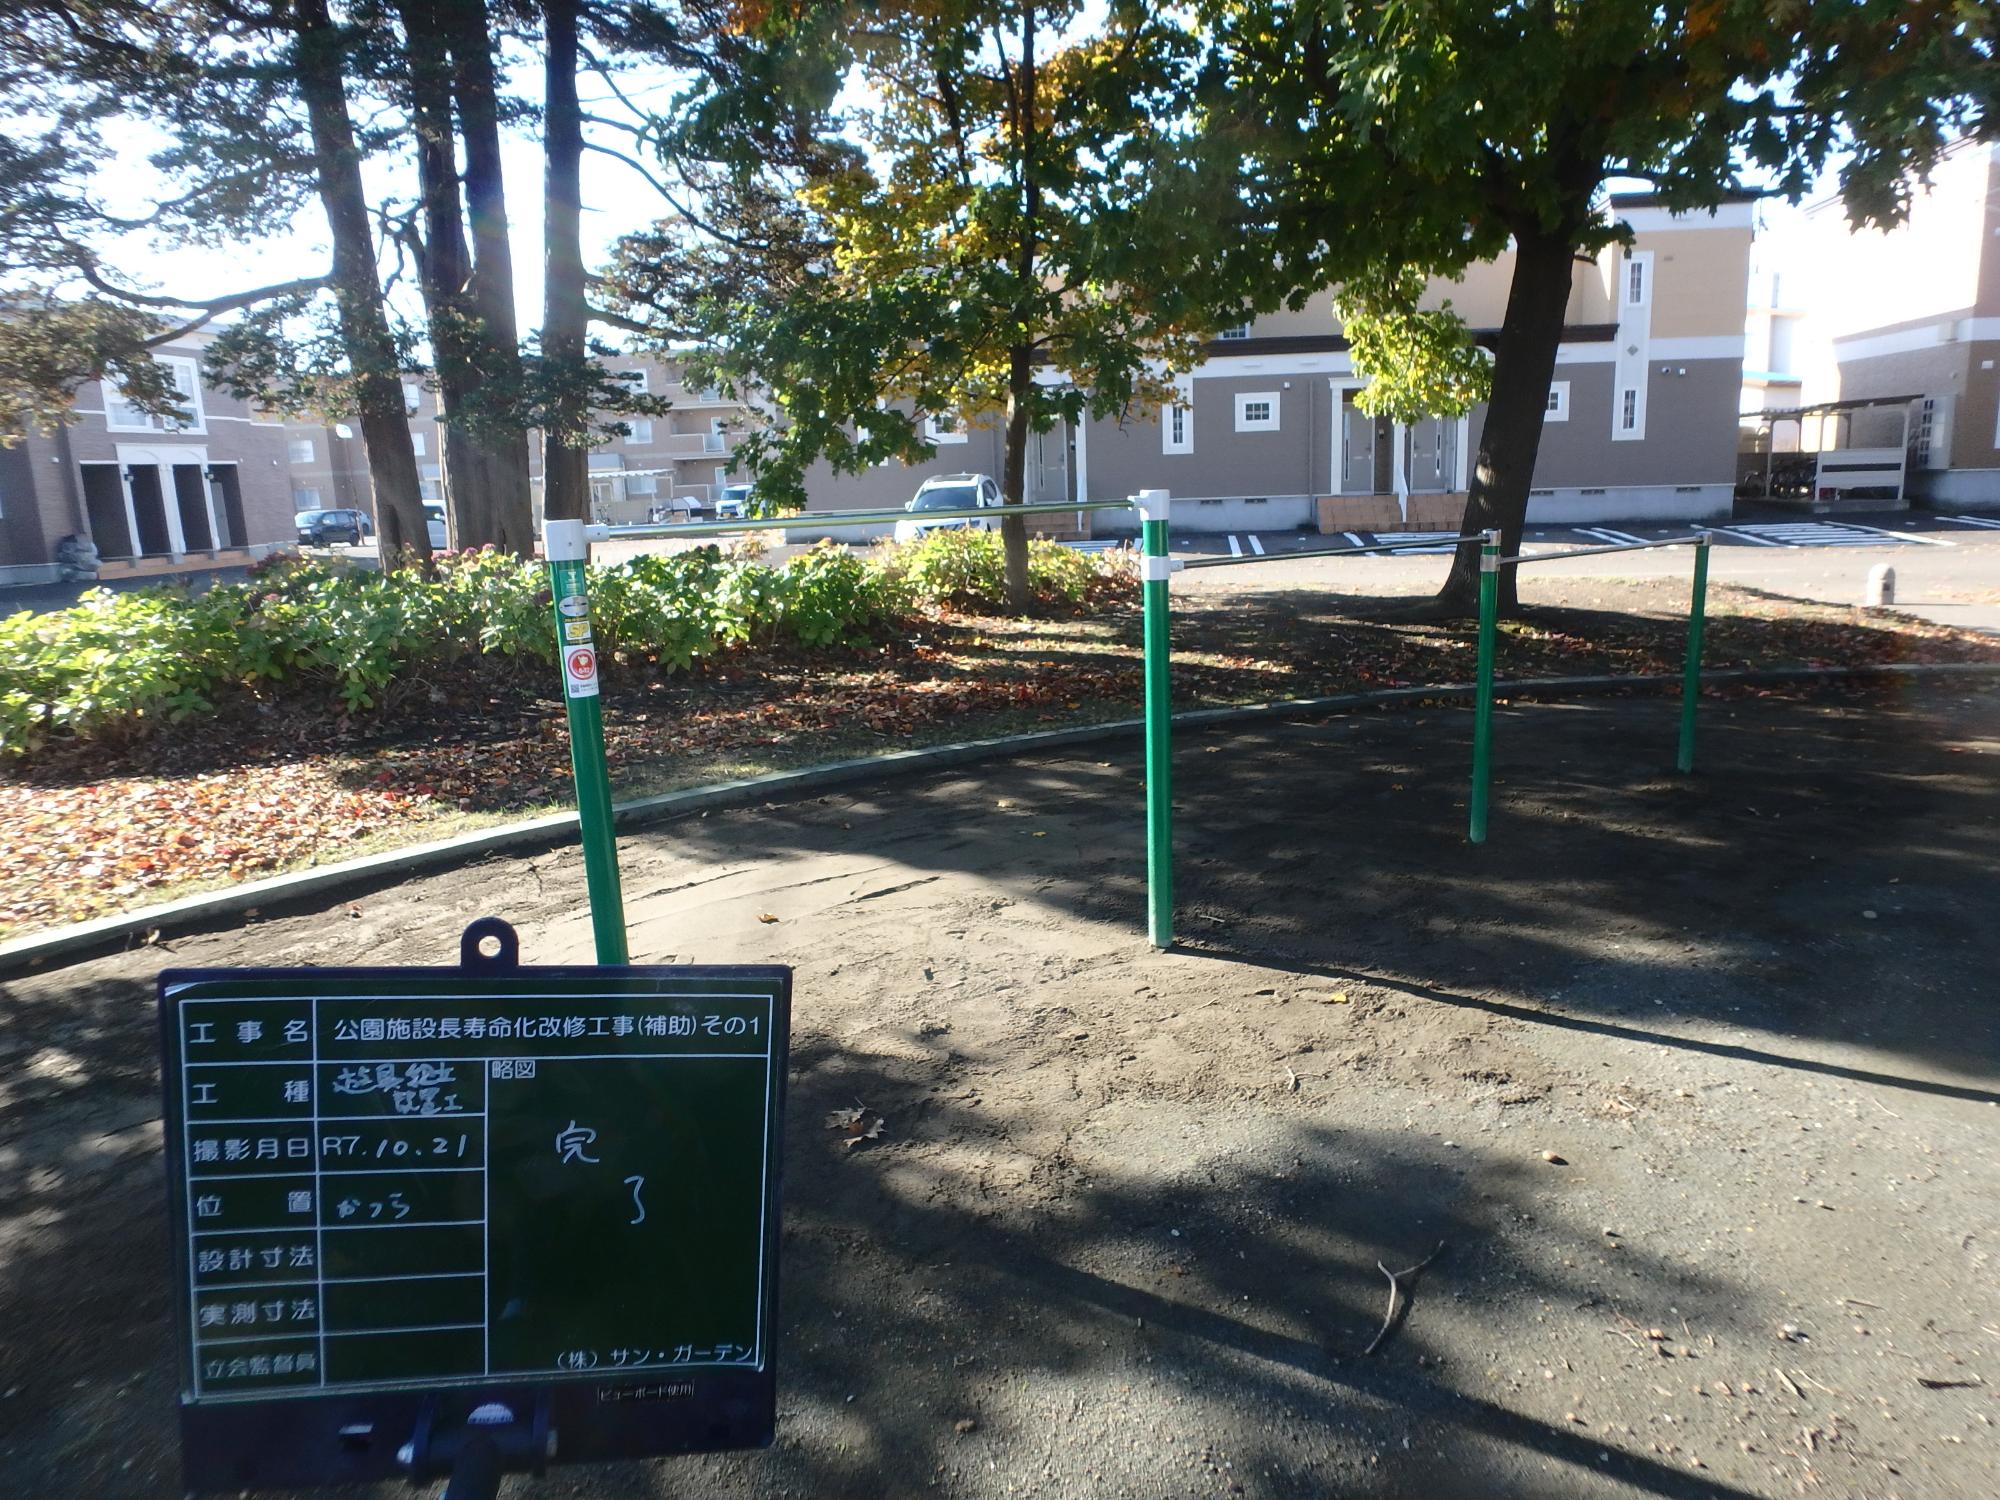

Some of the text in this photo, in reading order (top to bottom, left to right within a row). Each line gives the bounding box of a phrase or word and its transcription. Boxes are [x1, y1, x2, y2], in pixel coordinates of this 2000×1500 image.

[189, 1019, 308, 1043] 工事名
[491, 1060, 536, 1079] 略図
[191, 1079, 309, 1104] 工種
[193, 1137, 309, 1162] 撮影月日
[196, 1190, 313, 1217] 位置
[198, 1245, 314, 1273] 設計寸法
[199, 1298, 316, 1327] 実測寸法
